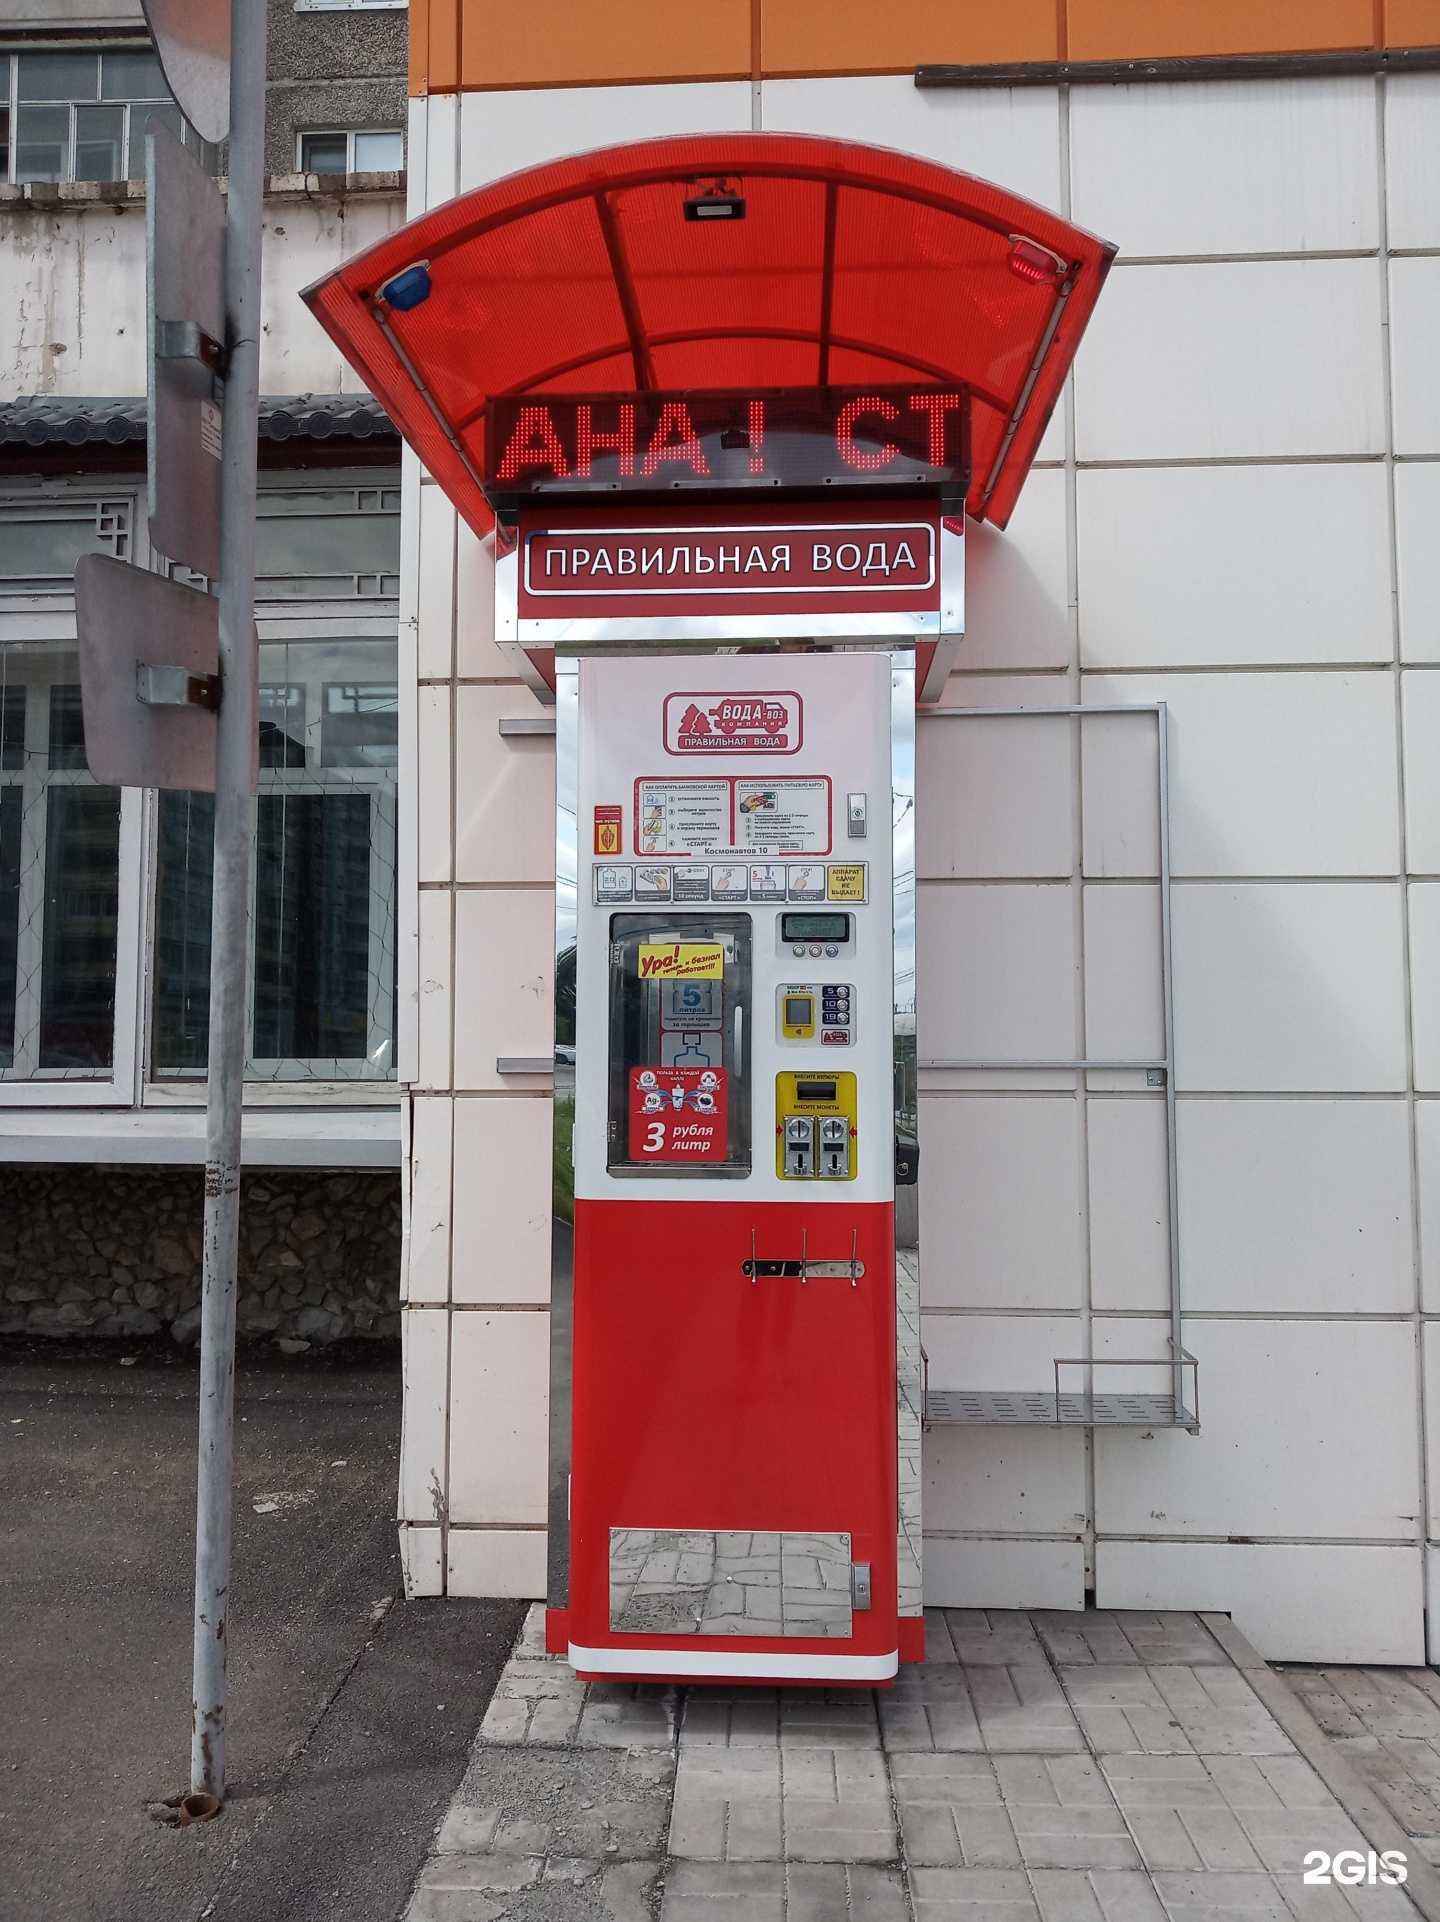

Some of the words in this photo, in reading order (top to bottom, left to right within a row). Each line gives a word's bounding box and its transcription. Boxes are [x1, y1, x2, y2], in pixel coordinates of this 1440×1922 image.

[836, 394, 960, 470] СТ
[545, 544, 792, 576] ПРАВИЛЬНАЯ
[811, 541, 917, 577] ВОДА
[684, 738, 747, 746] ПРАВИЛЬНАЯ
[754, 737, 781, 746] ВОДА
[704, 847, 756, 855] Космонавтов
[641, 944, 680, 977] Ура!
[682, 984, 702, 1007] 5
[642, 1122, 666, 1152] 3
[672, 1124, 714, 1138] рубля
[671, 1140, 711, 1152] литр
